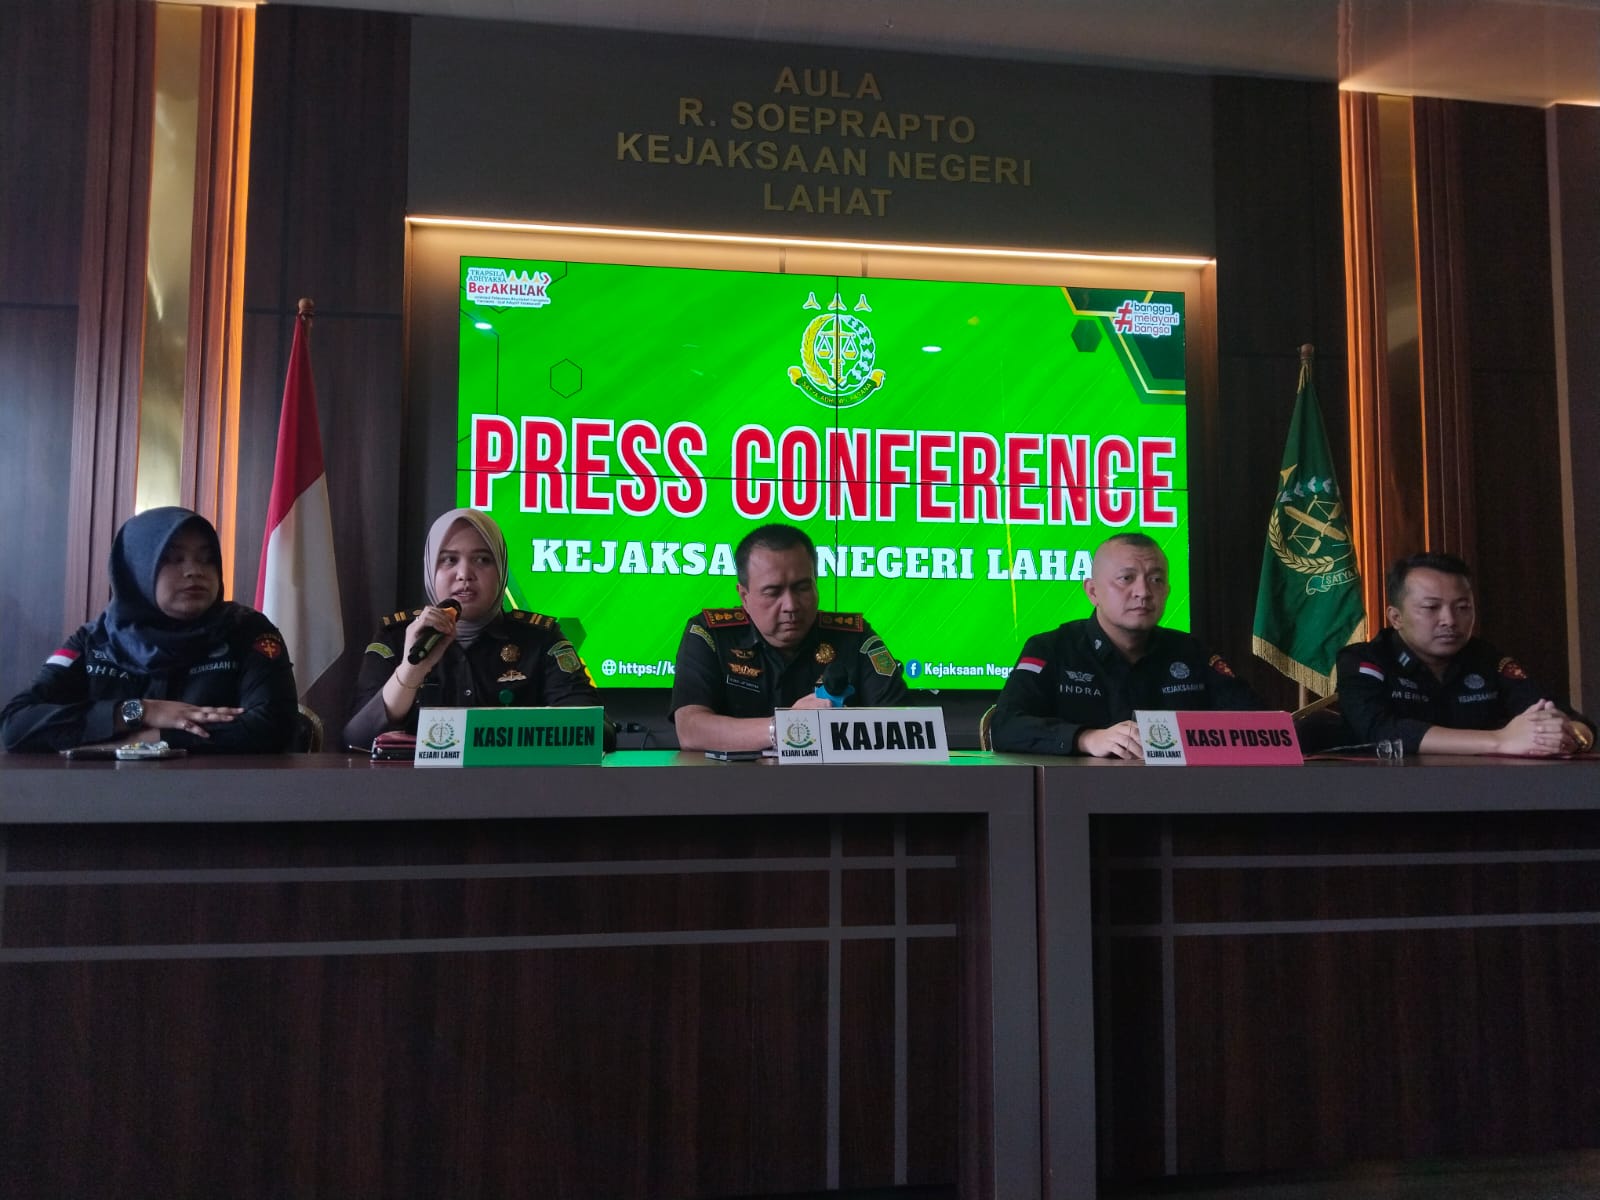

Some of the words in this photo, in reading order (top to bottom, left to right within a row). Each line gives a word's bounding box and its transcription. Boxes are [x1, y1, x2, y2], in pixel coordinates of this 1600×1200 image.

[774, 66, 882, 100] AULA
[678, 97, 717, 127] R.
[730, 101, 976, 144] SOEPRAPTO
[616, 132, 867, 176] KEJAKSAAN
[888, 151, 1032, 186] NEGERI
[763, 183, 892, 217] LAHAT
[469, 282, 545, 297] BerAKHLAK
[1134, 303, 1171, 315] bangga
[1134, 313, 1178, 325] melayani
[1134, 324, 1170, 335] bangsa
[471, 413, 707, 518] PRESS
[731, 423, 1177, 527] CONFERENCE
[531, 538, 737, 577] KEJAKSA
[818, 545, 974, 580] NEGERI
[987, 548, 1093, 581] LAHA
[618, 661, 676, 677] https://k
[924, 663, 983, 678] Kejaksaan
[1059, 684, 1102, 697] INDRA
[473, 727, 513, 747] KASI
[517, 726, 594, 747] INTELIJEN
[830, 721, 937, 750] KAJARI
[1185, 729, 1225, 747] KASI
[1229, 729, 1293, 747] PIDSUS
[418, 751, 440, 759] KEJARI
[440, 751, 460, 759] LAHAT
[781, 749, 801, 757] KEJARI
[801, 749, 818, 757] LAHAT
[1165, 750, 1181, 758] LAHAT
